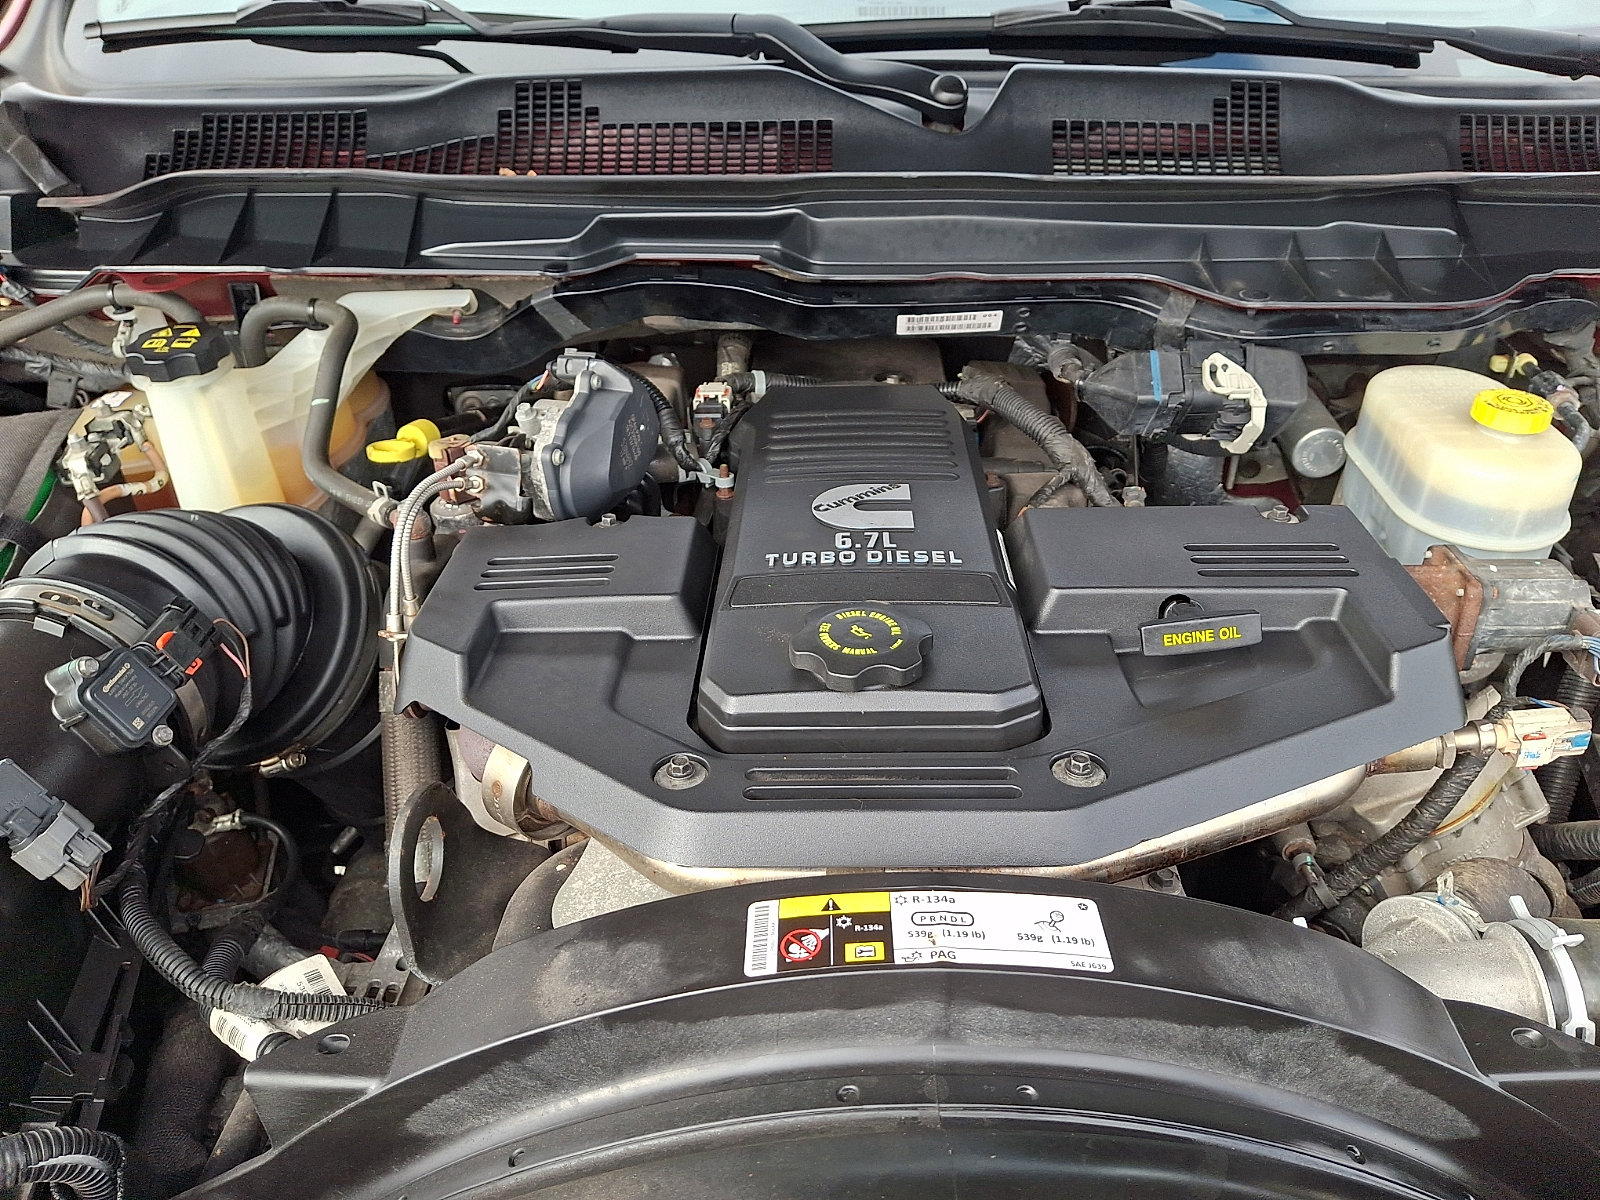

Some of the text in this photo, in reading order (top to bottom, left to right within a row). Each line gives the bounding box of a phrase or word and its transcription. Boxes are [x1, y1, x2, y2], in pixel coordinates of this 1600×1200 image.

[813, 483, 902, 513] Cummins
[834, 531, 898, 550] 6.7L
[765, 549, 963, 568] TURBO DIESEL
[834, 610, 867, 620] DIESEL
[1163, 626, 1242, 647] ENGINE OIL
[841, 646, 878, 656] MANUAL
[912, 895, 956, 904] R-134a
[854, 924, 884, 932] R-134a
[971, 930, 986, 940] lb)
[1080, 937, 1095, 947] lb)
[930, 950, 957, 960] PAG
[1070, 960, 1086, 968] SAE
